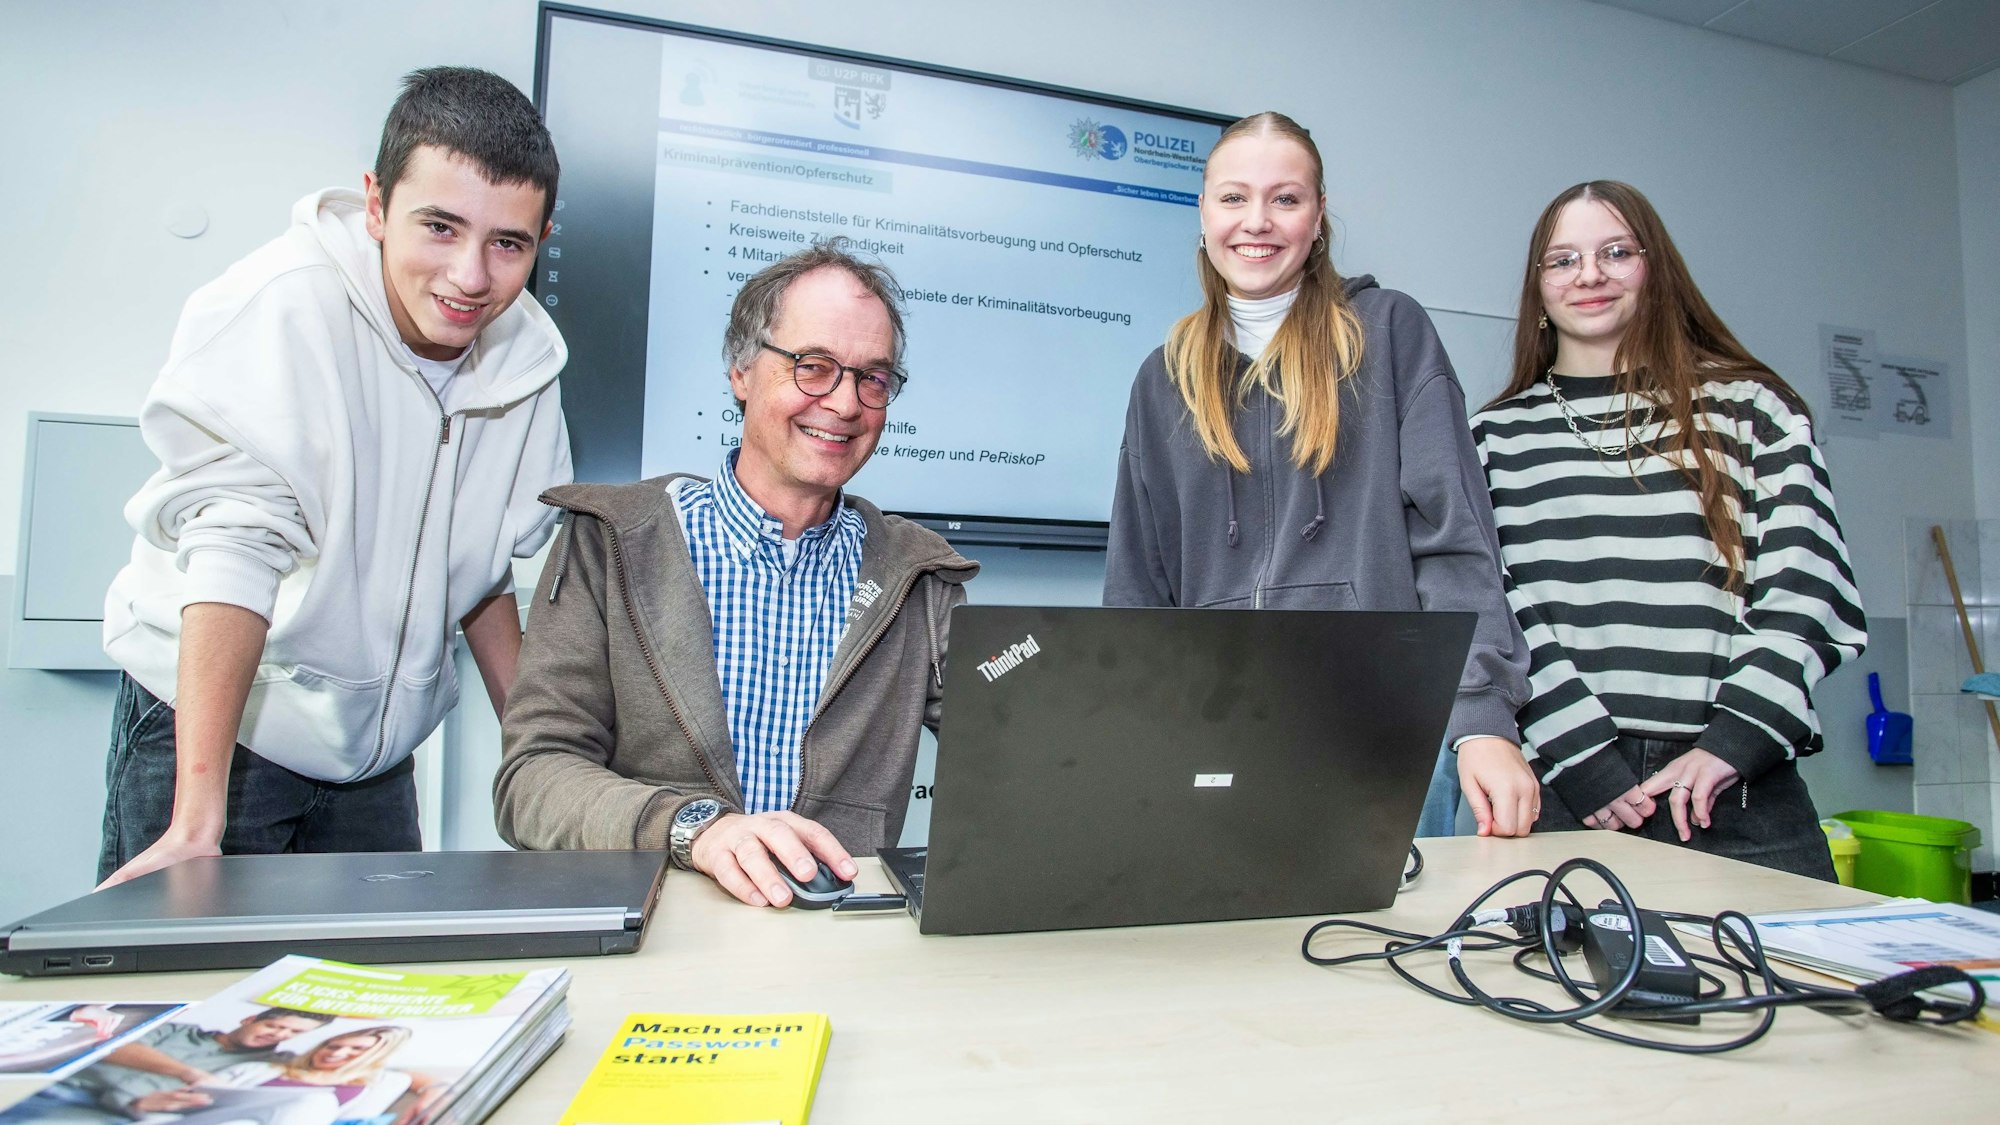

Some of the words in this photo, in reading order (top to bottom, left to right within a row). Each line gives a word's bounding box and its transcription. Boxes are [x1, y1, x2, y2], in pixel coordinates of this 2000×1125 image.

[861, 71, 885, 85] RFK
[817, 141, 869, 157] professionell
[1134, 131, 1195, 153] POLIZEI
[1134, 147, 1207, 164] Nordrhein-Westfalen
[1134, 156, 1189, 171] Oberbergischer
[664, 147, 873, 185] Kriminalprävention/Opferschutz
[1140, 188, 1159, 198] leben
[1160, 191, 1168, 199] in
[730, 200, 848, 225] Fachdienststelle
[852, 214, 871, 229] für
[875, 217, 1036, 251] Kriminalitätsvorbeugung
[1040, 240, 1064, 252] und
[1068, 242, 1143, 263] Opferschutz
[730, 222, 805, 243] Kreisweite
[728, 246, 737, 258] 4
[952, 293, 973, 306] der
[978, 295, 1131, 326] Kriminalitätsvorbeugung
[894, 444, 945, 461] kriegen
[949, 449, 974, 462] und
[979, 450, 1045, 466] PeRiskoP
[867, 579, 883, 595] ONE
[858, 590, 876, 603] ONE
[976, 634, 1041, 683] ThinkPad
[267, 991, 310, 1006] FÜR
[632, 1023, 721, 1034] Mach
[733, 1023, 803, 1034] dein
[622, 1037, 781, 1049] Passwort
[612, 1053, 719, 1065] stark!
